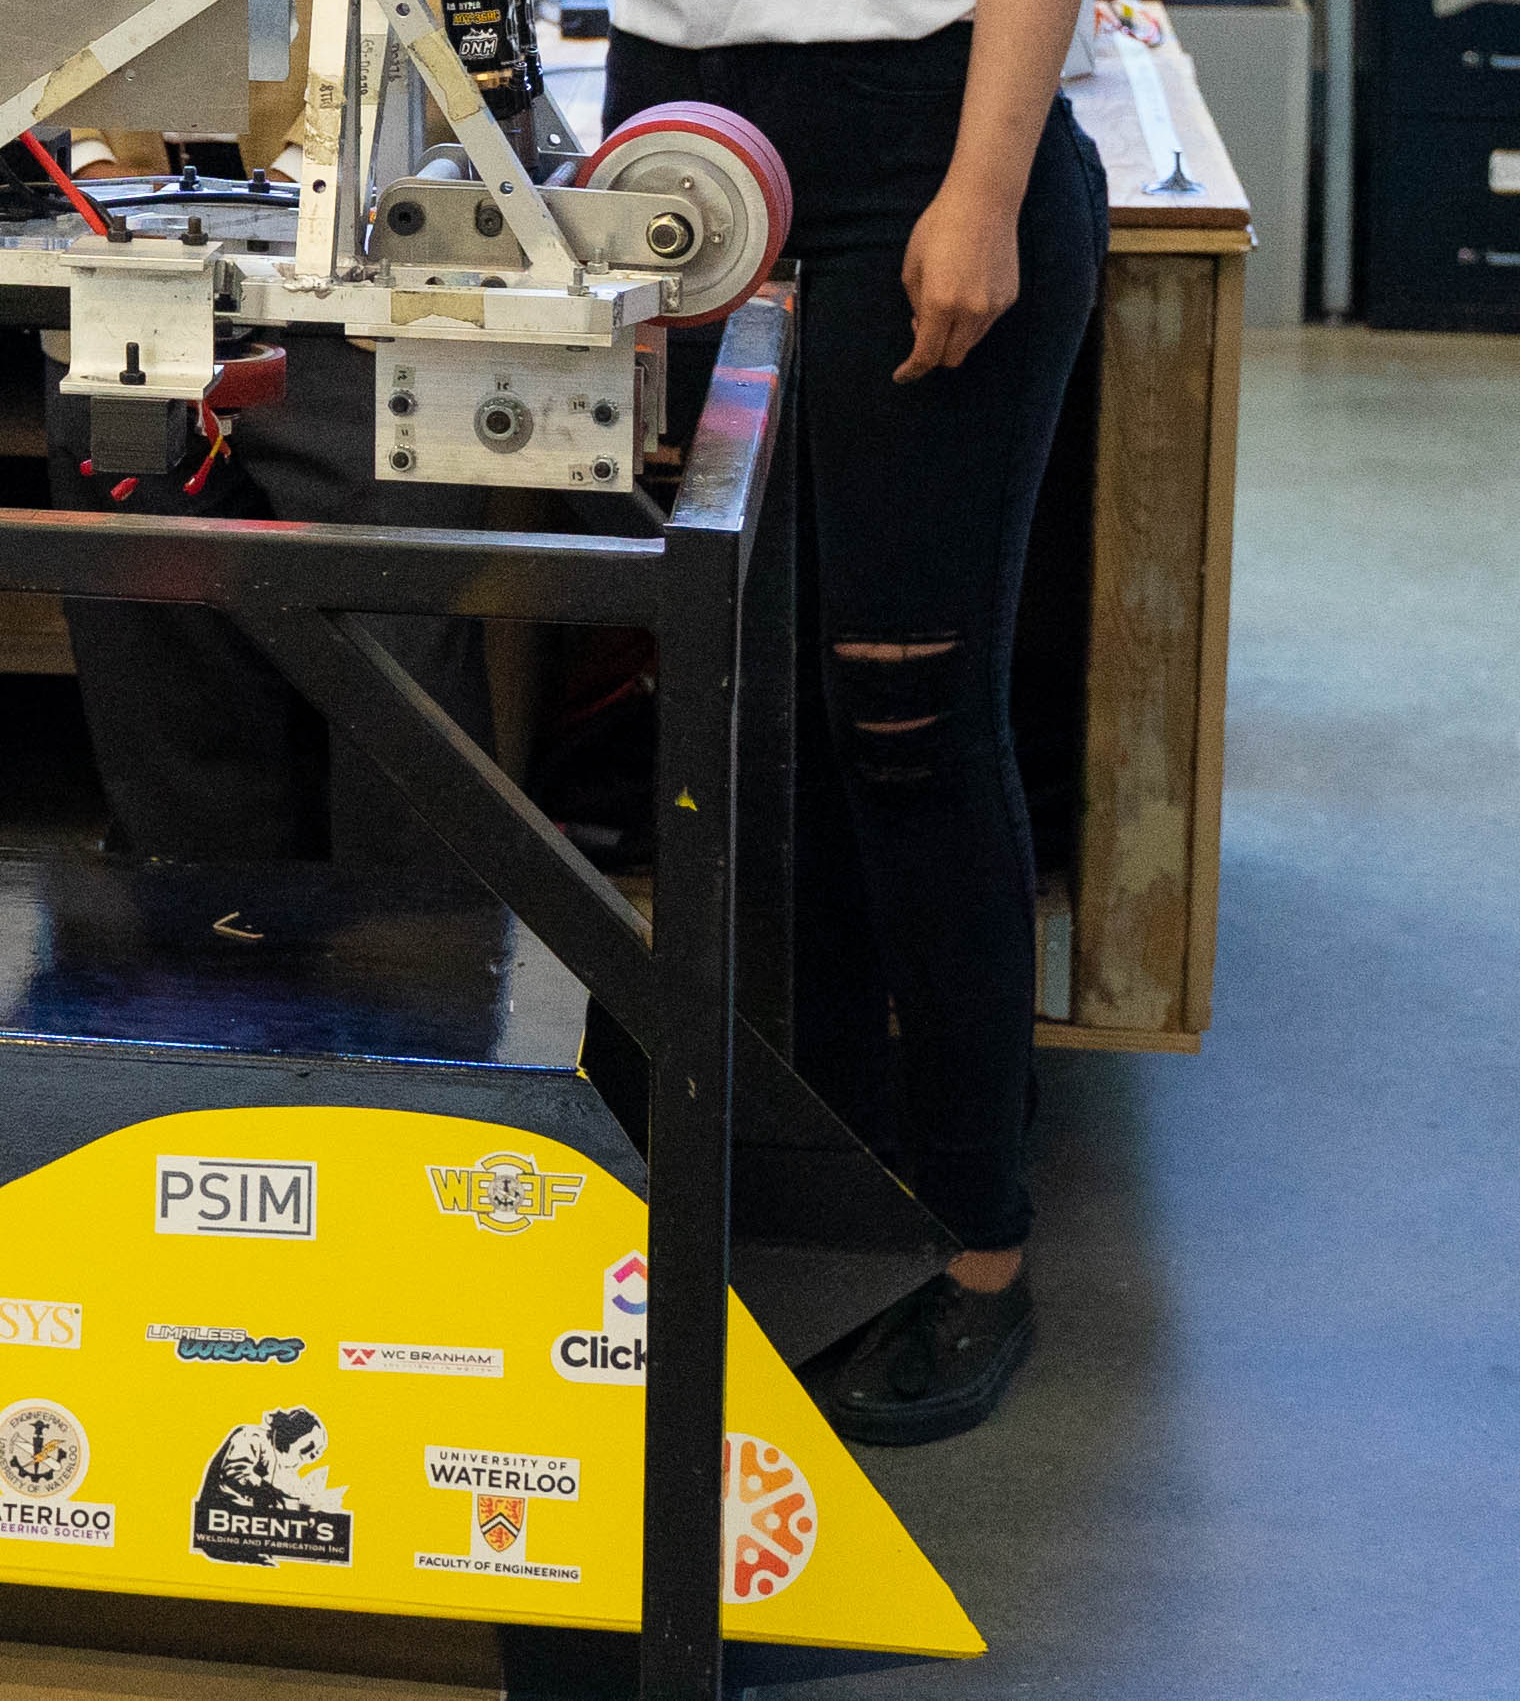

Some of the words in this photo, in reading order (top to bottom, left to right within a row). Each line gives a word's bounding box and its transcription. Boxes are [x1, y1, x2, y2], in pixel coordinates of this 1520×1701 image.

[461, 39, 496, 56] DNM
[573, 401, 586, 410] 14
[572, 471, 584, 482] 13
[161, 1170, 301, 1224] PSIM
[147, 1324, 247, 1342] LIMITLESS
[177, 1337, 305, 1363] WRAPS
[381, 1349, 406, 1360] WC
[410, 1350, 493, 1364] BRANHAM
[561, 1336, 647, 1371] Click
[10, 1410, 68, 1434] ENGINEERING
[27, 1485, 42, 1494] OF
[45, 1445, 78, 1492] WATERLOO
[440, 1451, 538, 1468] UNIVERSITY
[547, 1460, 568, 1471] OF
[431, 1463, 576, 1495] WATERLOO
[54, 1528, 110, 1540] SOCIETY
[208, 1508, 334, 1541] BRENT'S
[418, 1555, 472, 1569] FACULTY
[474, 1561, 491, 1570] OF
[495, 1563, 579, 1580] ENGINEERING
